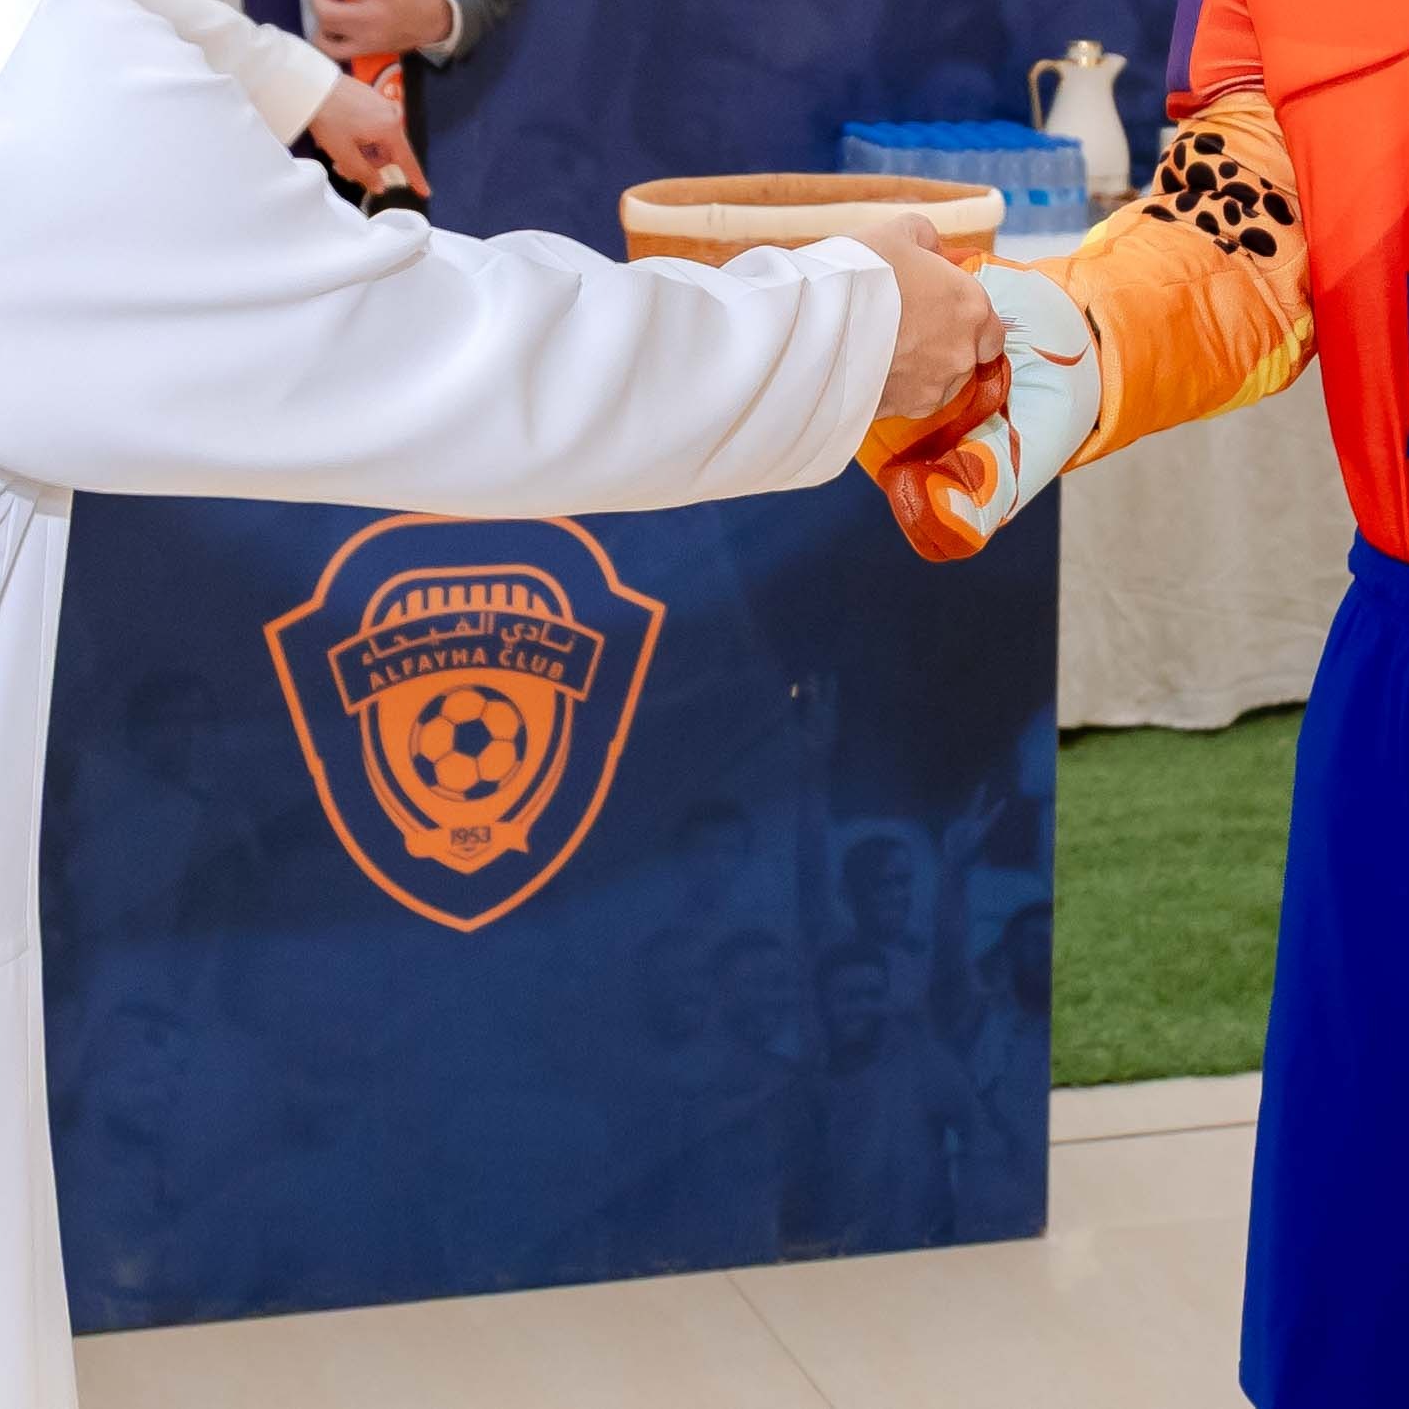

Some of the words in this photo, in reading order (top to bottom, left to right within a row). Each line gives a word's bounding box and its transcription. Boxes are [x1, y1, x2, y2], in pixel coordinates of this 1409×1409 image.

[361, 612, 496, 666] الفيحاء
[500, 621, 575, 655] نادي
[369, 646, 487, 691] ALFAYHA
[498, 648, 566, 681] CLUB
